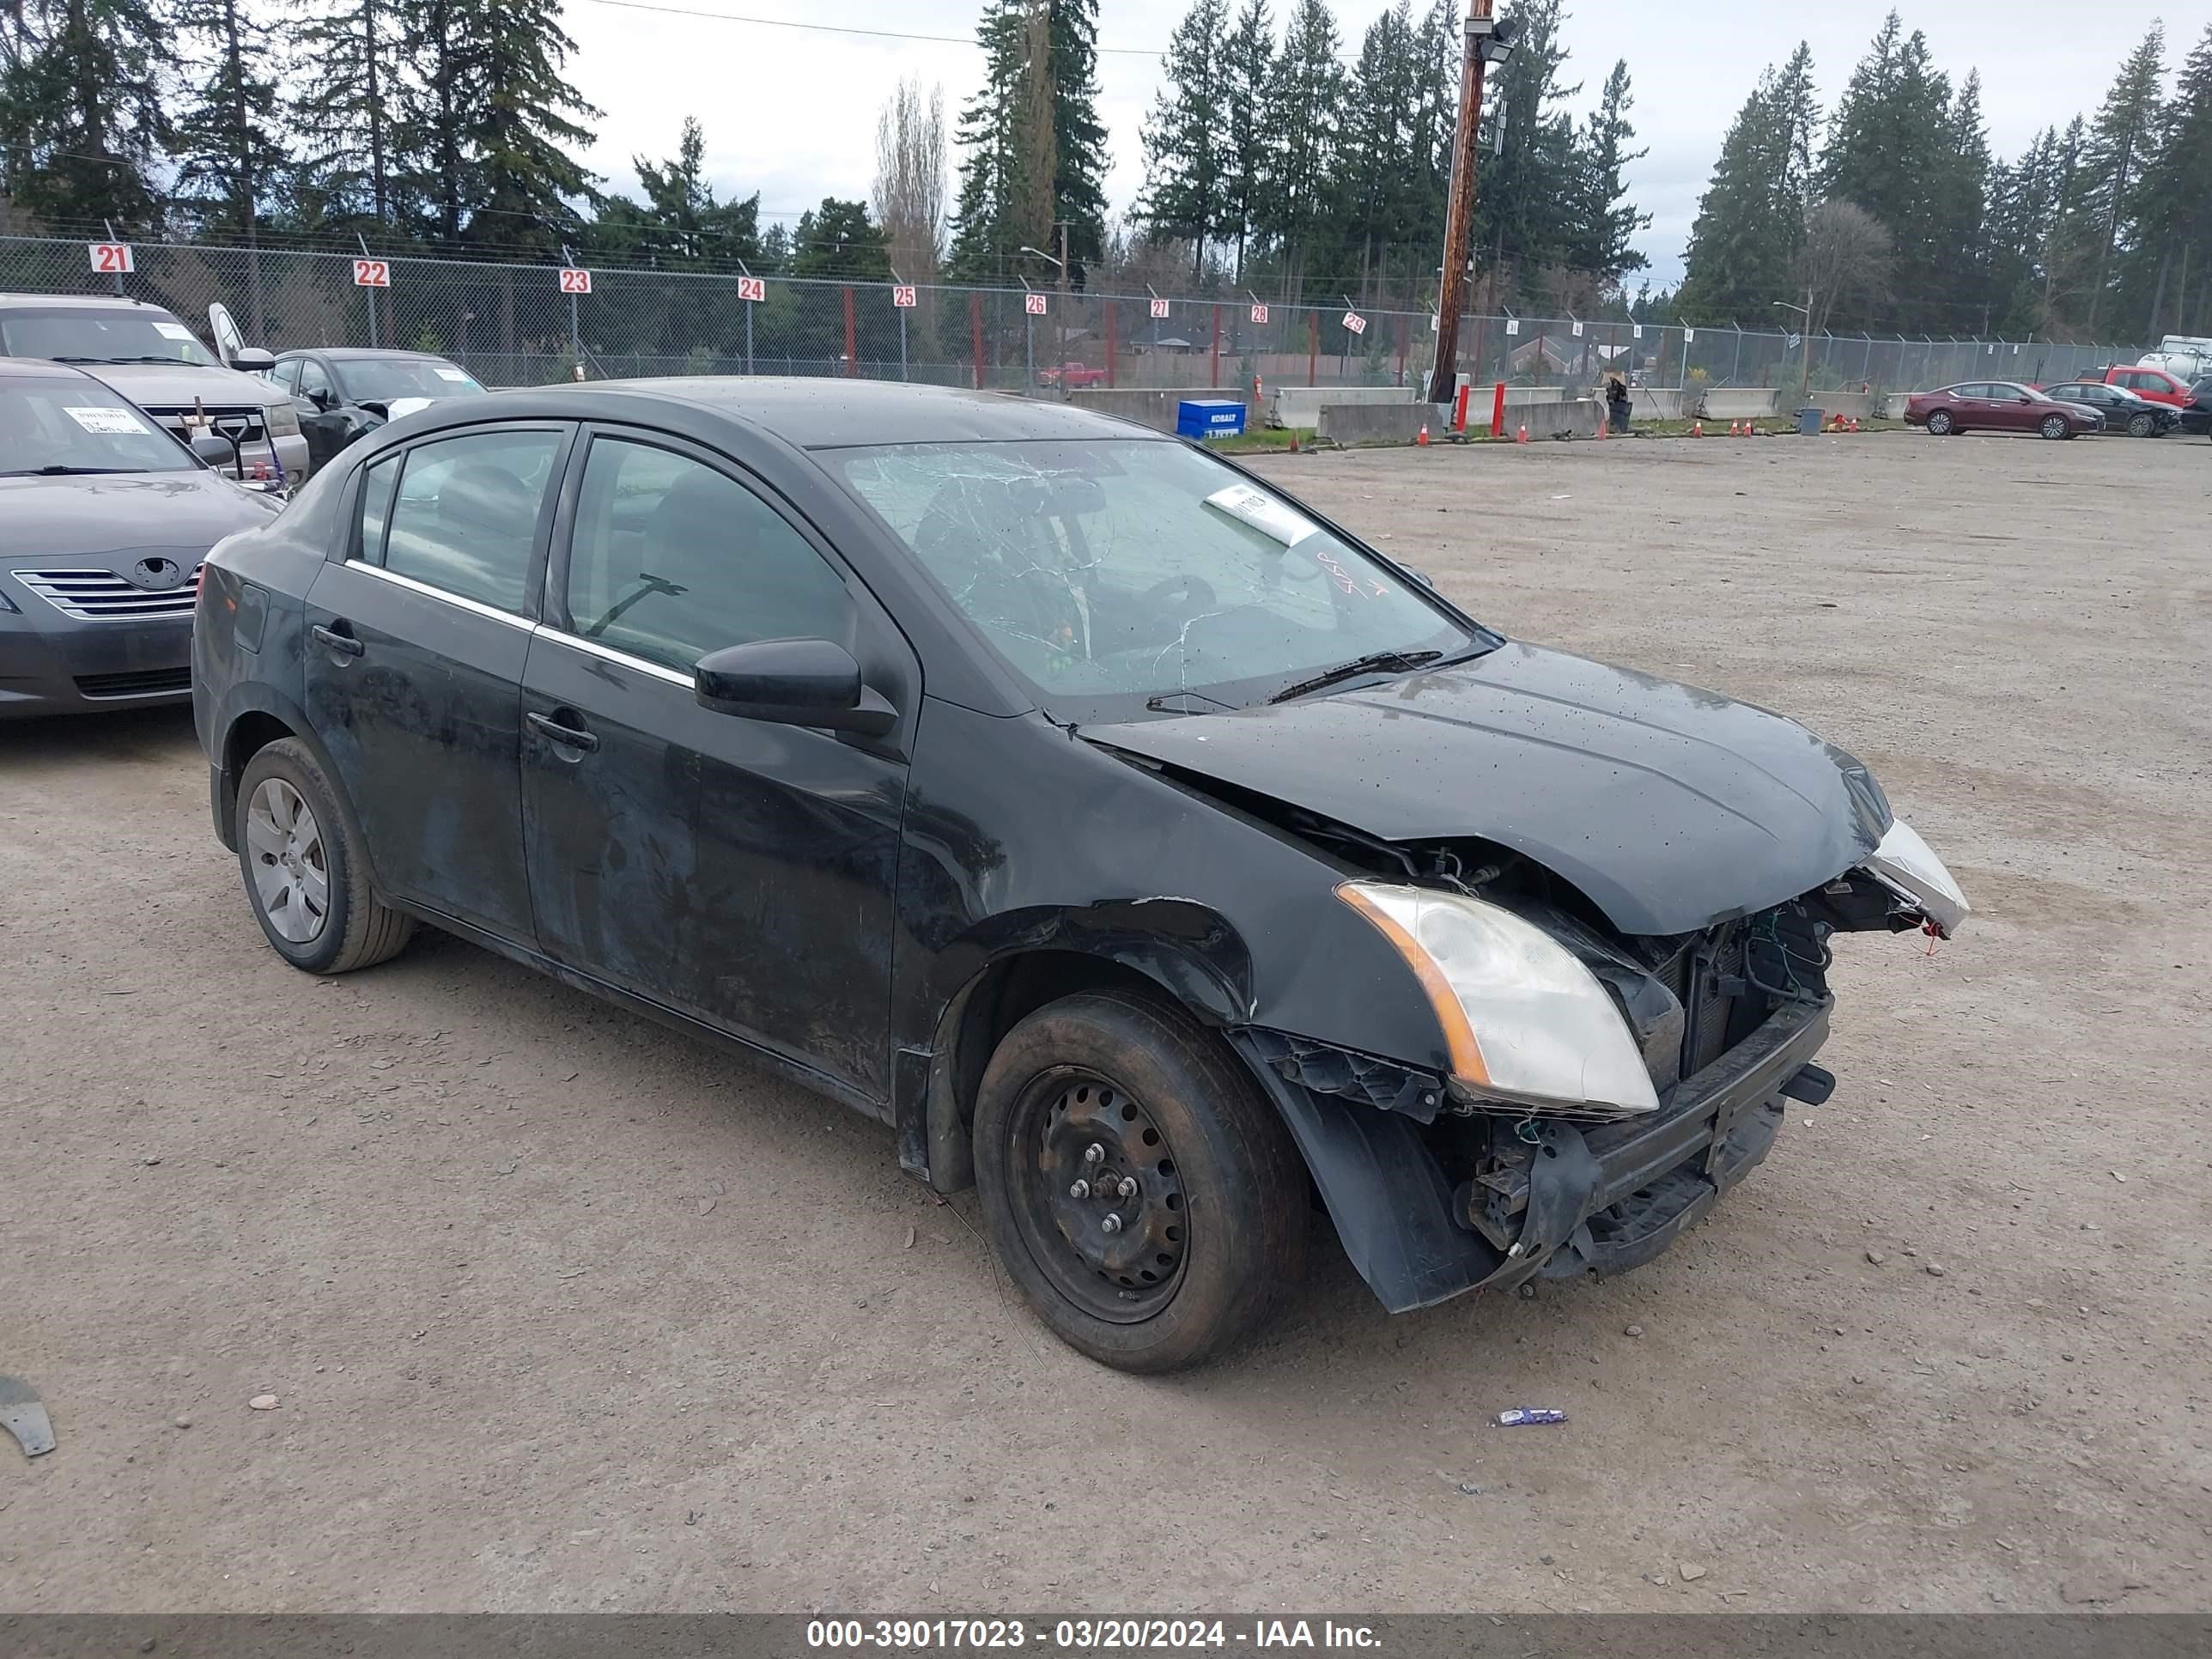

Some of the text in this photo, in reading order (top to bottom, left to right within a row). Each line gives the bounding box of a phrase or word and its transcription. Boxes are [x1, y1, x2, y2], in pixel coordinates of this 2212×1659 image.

[98, 246, 127, 271] 21
[357, 262, 386, 285] 22
[563, 271, 588, 292] 23
[741, 278, 763, 299] 24
[896, 288, 914, 307] 25
[1028, 296, 1044, 314] 26
[1153, 301, 1168, 318] 27
[1254, 306, 1266, 322] 28
[1346, 313, 1364, 331] 29
[1211, 414, 1237, 423] KOBALT
